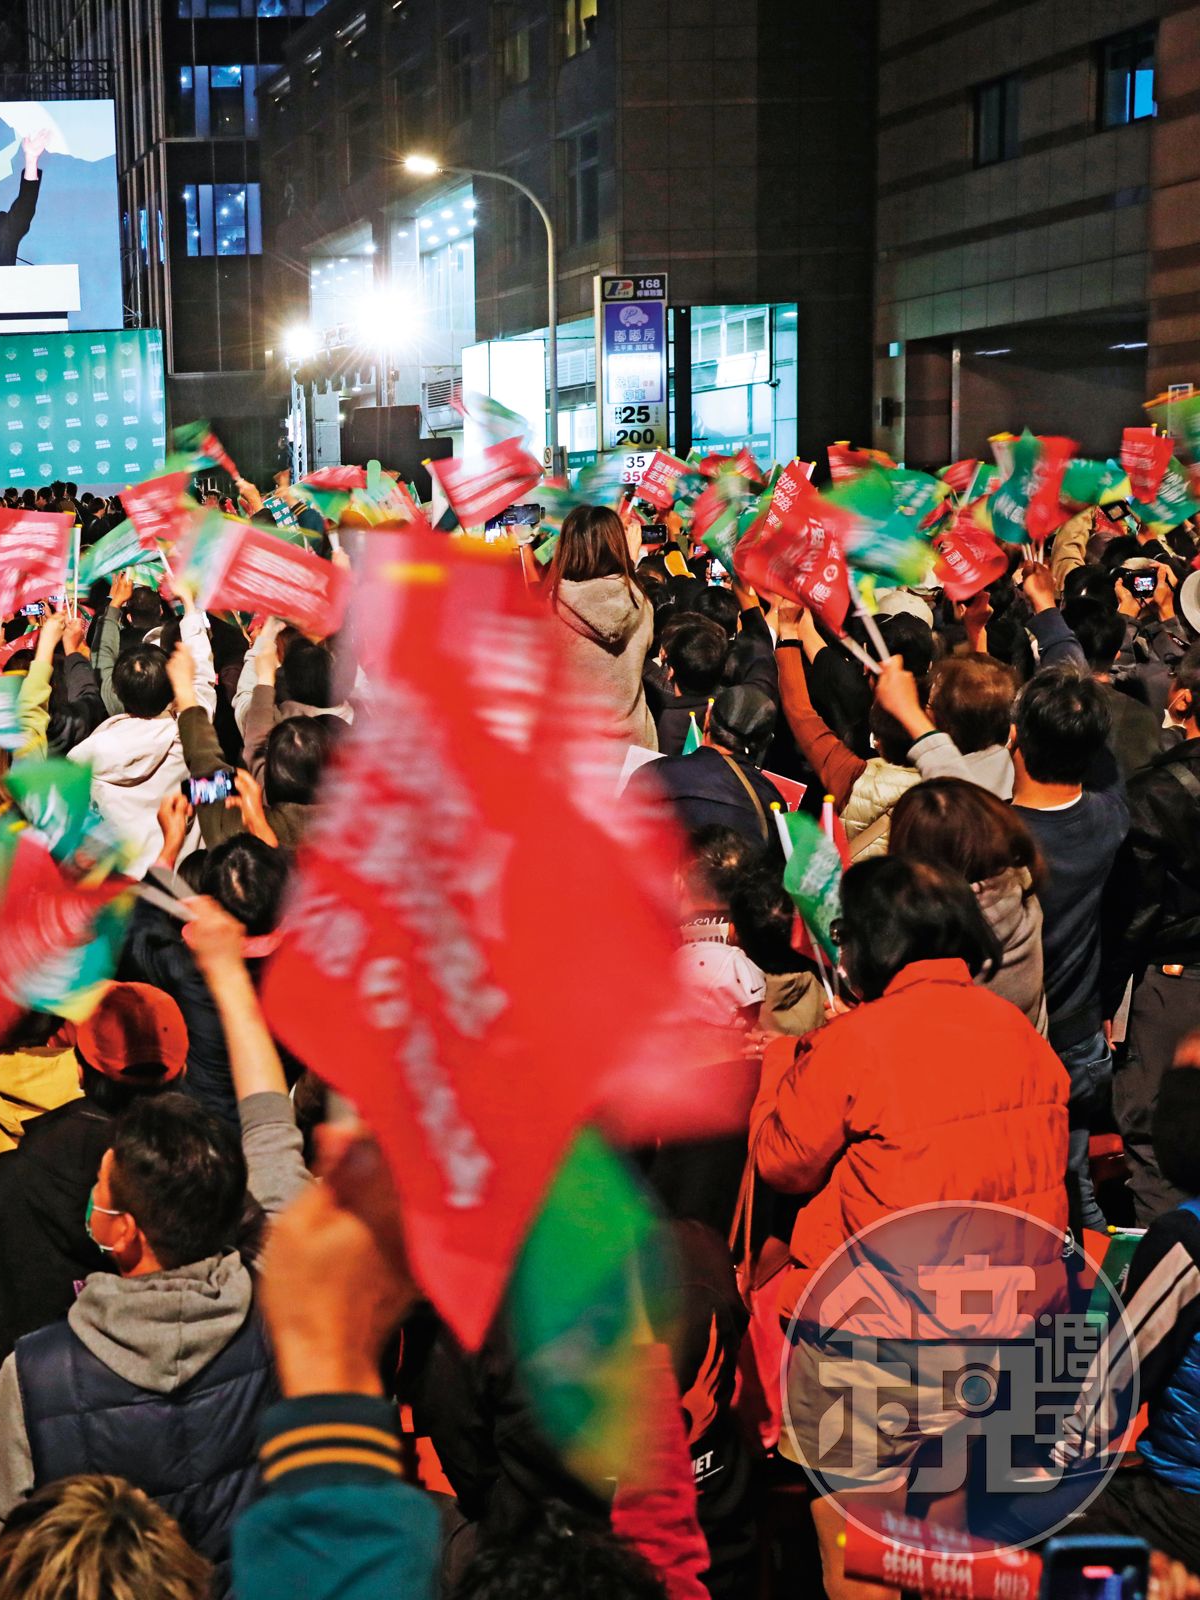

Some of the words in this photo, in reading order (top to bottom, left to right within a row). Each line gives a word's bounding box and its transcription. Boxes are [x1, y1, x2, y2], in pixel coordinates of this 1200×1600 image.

[639, 279, 660, 289] 168
[621, 405, 650, 424] 25
[616, 428, 655, 446] 200
[626, 456, 645, 469] 35
